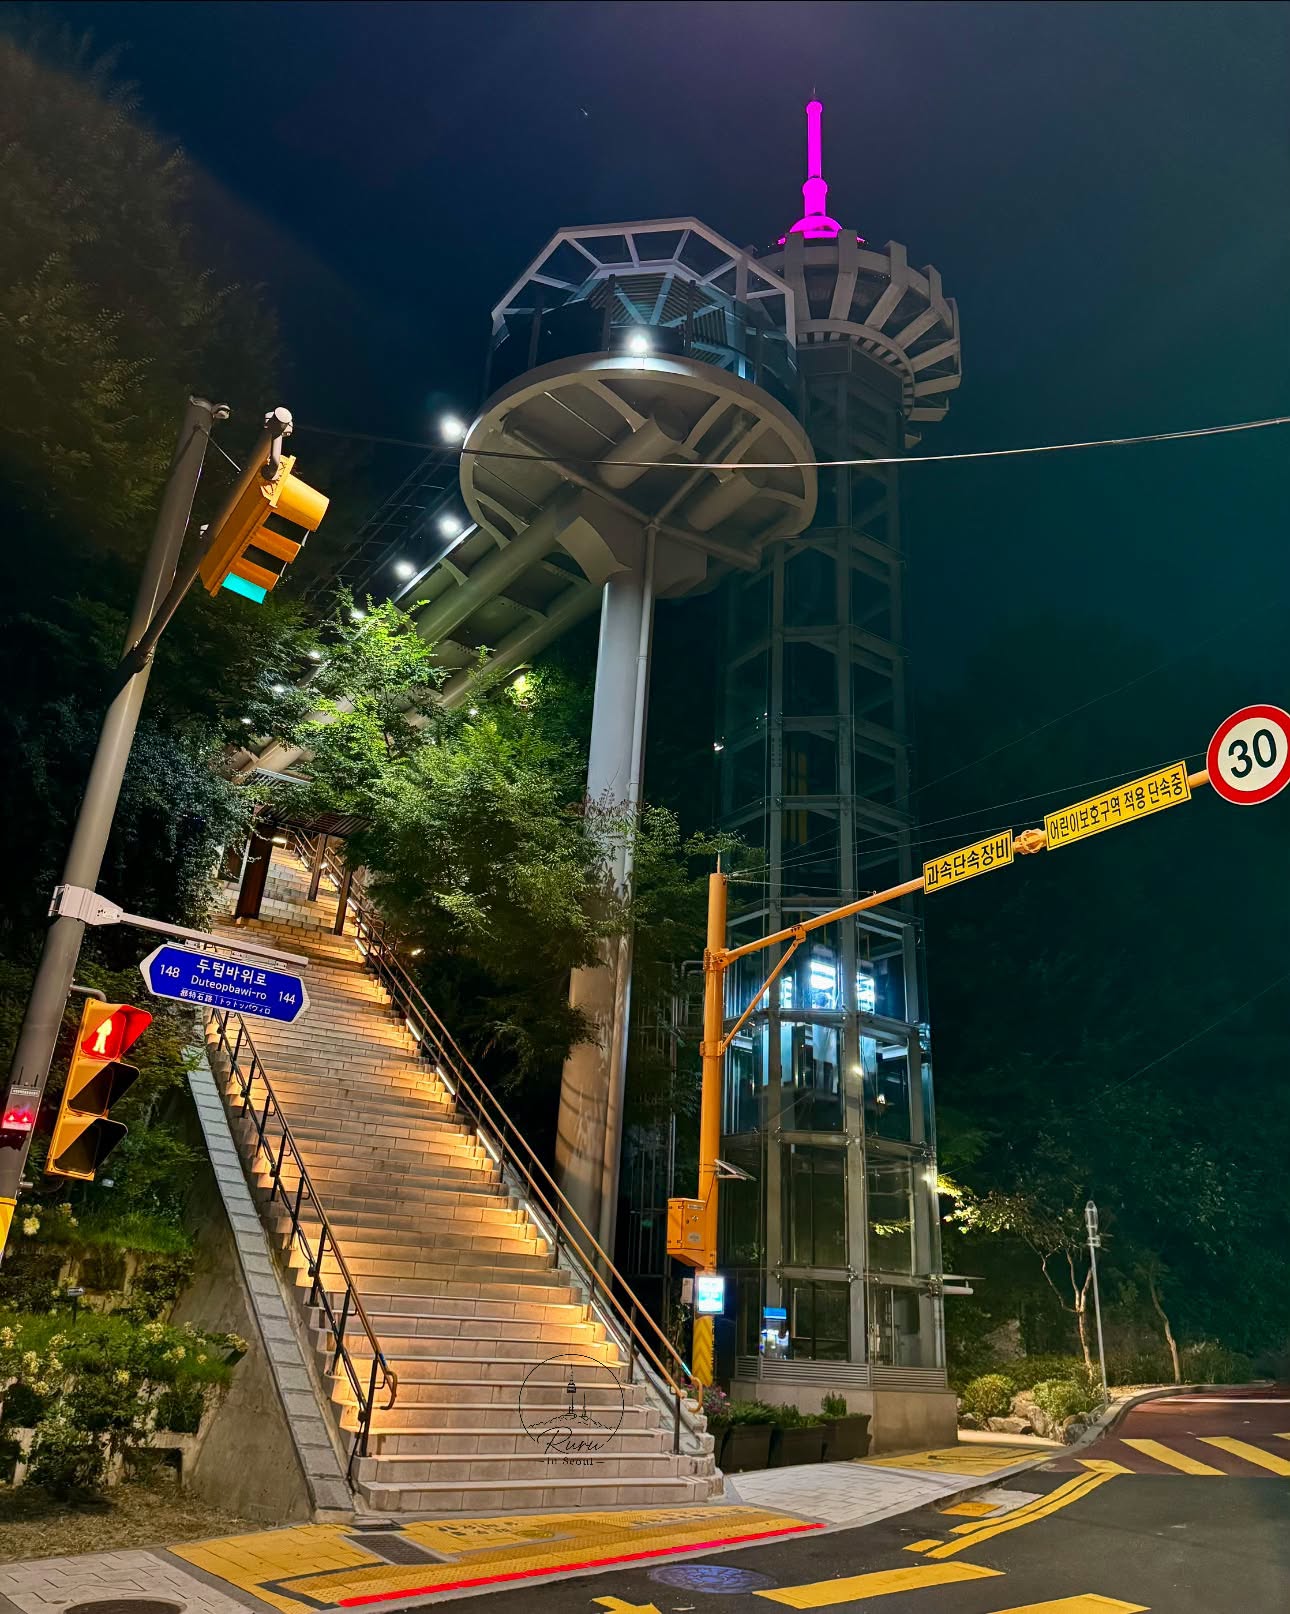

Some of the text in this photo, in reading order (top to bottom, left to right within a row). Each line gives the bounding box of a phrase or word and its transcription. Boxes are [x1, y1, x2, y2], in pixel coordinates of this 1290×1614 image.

[1227, 728, 1278, 779] 30
[1050, 772, 1183, 840] 어린이보호구역 적용 단속중
[927, 837, 1010, 886] 과속단속장비
[159, 964, 181, 979] 148
[196, 959, 268, 987] 두텁바위로
[190, 975, 268, 1001] Duteopbawi-ro
[278, 991, 296, 1005] 144
